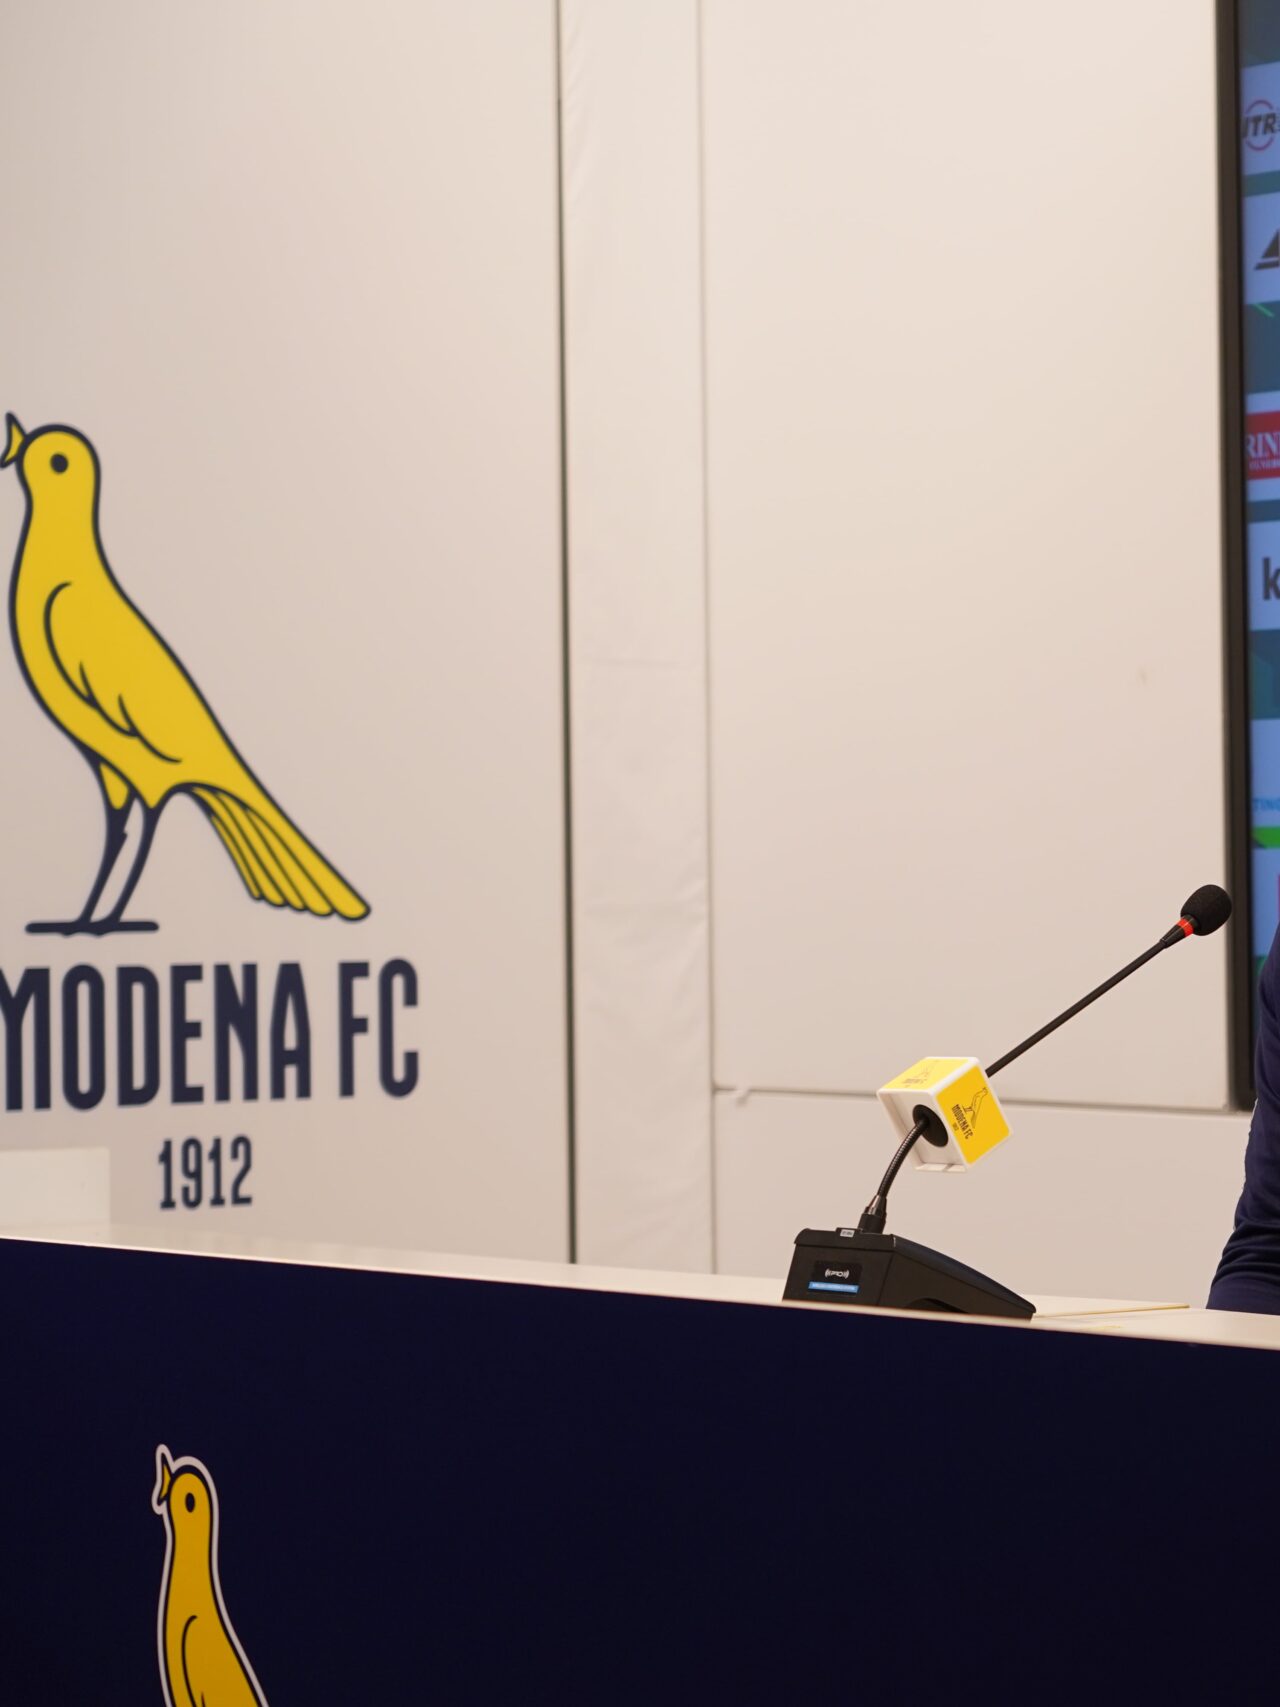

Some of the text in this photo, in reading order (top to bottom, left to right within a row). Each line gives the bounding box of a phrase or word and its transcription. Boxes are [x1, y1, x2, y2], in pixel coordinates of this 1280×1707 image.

[0, 957, 419, 1112] MODENA FC
[952, 1104, 969, 1131] MODENA
[964, 1129, 973, 1139] FC
[159, 1135, 253, 1210] 1912
